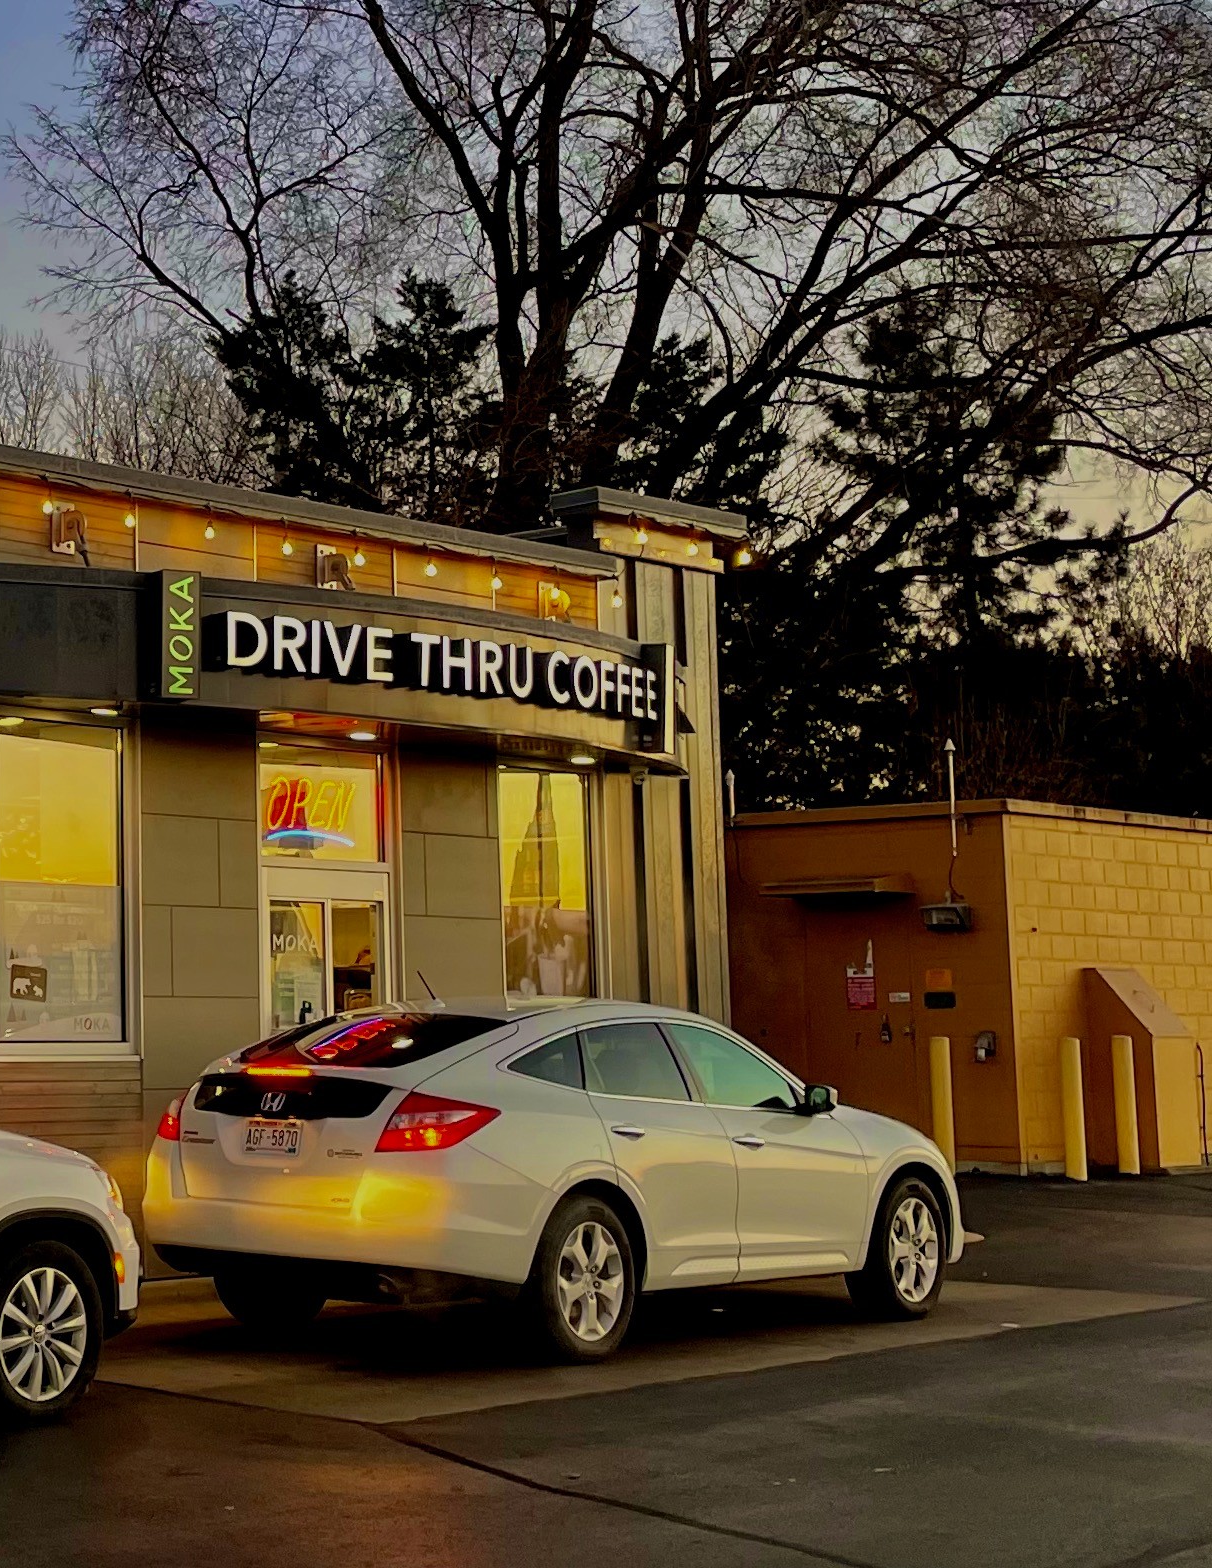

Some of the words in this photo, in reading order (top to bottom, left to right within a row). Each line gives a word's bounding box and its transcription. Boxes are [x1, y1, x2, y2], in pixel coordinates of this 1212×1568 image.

[169, 575, 196, 696] MOKA
[226, 609, 395, 683] DRIVE
[410, 632, 534, 699] THRU
[547, 650, 659, 722] COFFEE
[266, 775, 357, 833] OPEN
[272, 932, 319, 953] MOKA
[73, 1017, 111, 1031] MOKA
[245, 1128, 299, 1148] AGF-5870
